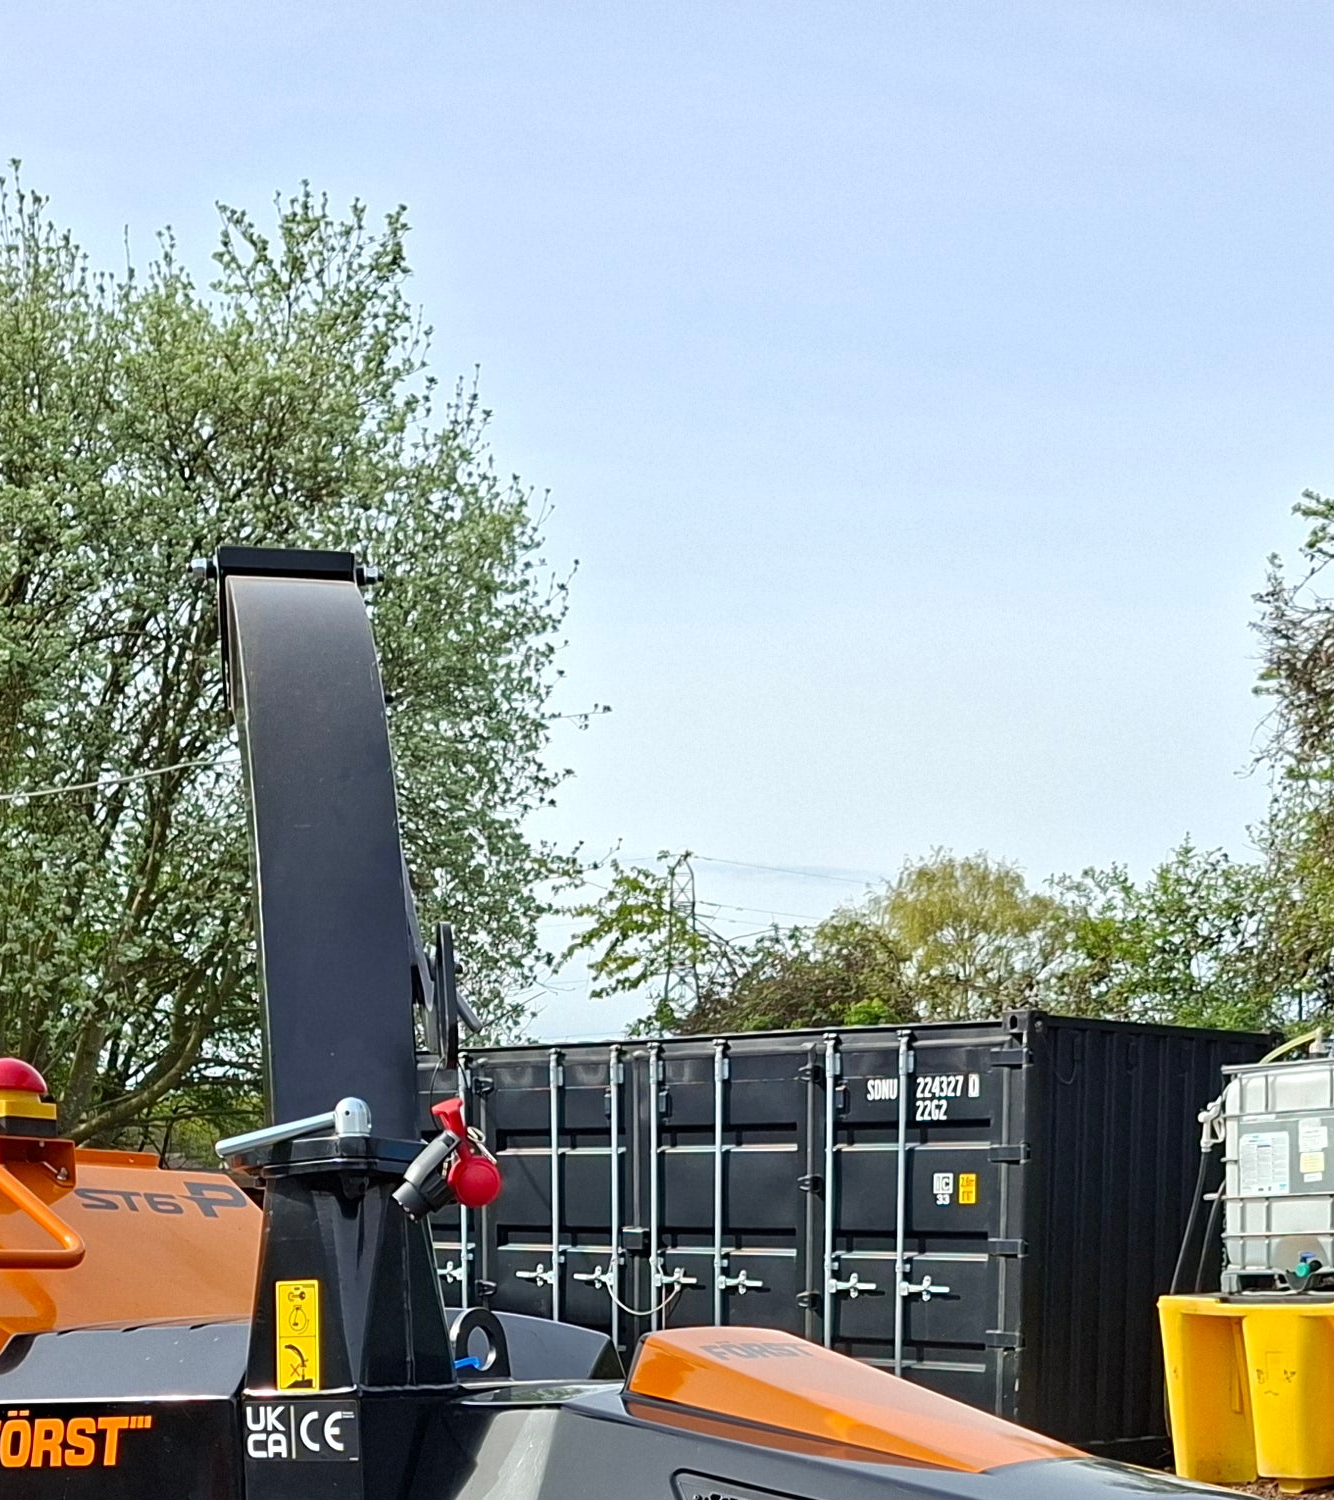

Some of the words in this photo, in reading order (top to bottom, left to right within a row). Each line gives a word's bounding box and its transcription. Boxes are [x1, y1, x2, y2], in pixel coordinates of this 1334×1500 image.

[866, 1079, 898, 1100] SDNU
[916, 1075, 964, 1098] 224327
[915, 1099, 947, 1121] 22G2
[246, 1406, 286, 1431] UK
